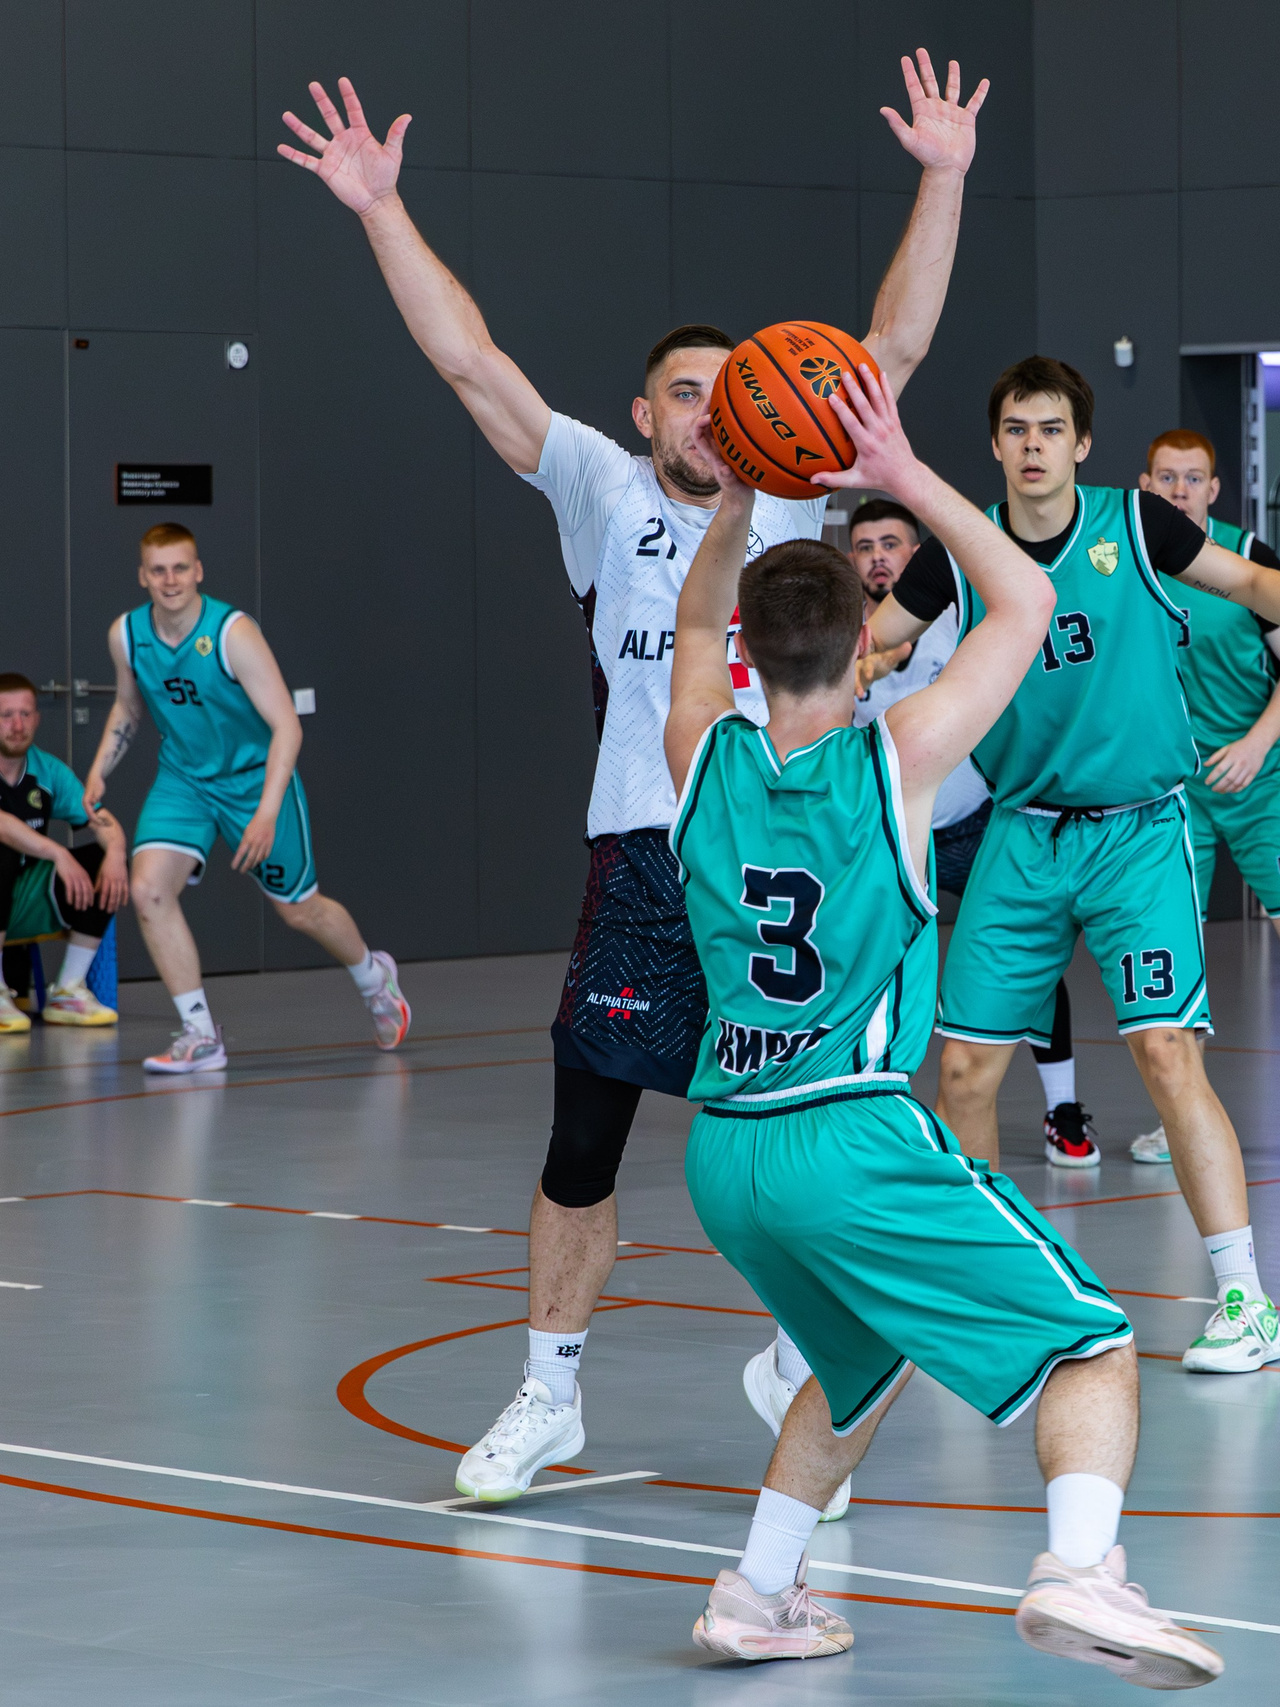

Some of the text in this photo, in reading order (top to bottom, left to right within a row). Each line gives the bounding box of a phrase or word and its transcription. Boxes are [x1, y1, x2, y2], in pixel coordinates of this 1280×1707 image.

[735, 356, 798, 441] DEMIX
[1040, 610, 1096, 673] 13
[163, 677, 203, 707] 52
[739, 862, 826, 1007] 3
[586, 991, 651, 1012] ALPHATEAM
[1119, 947, 1176, 1005] 13
